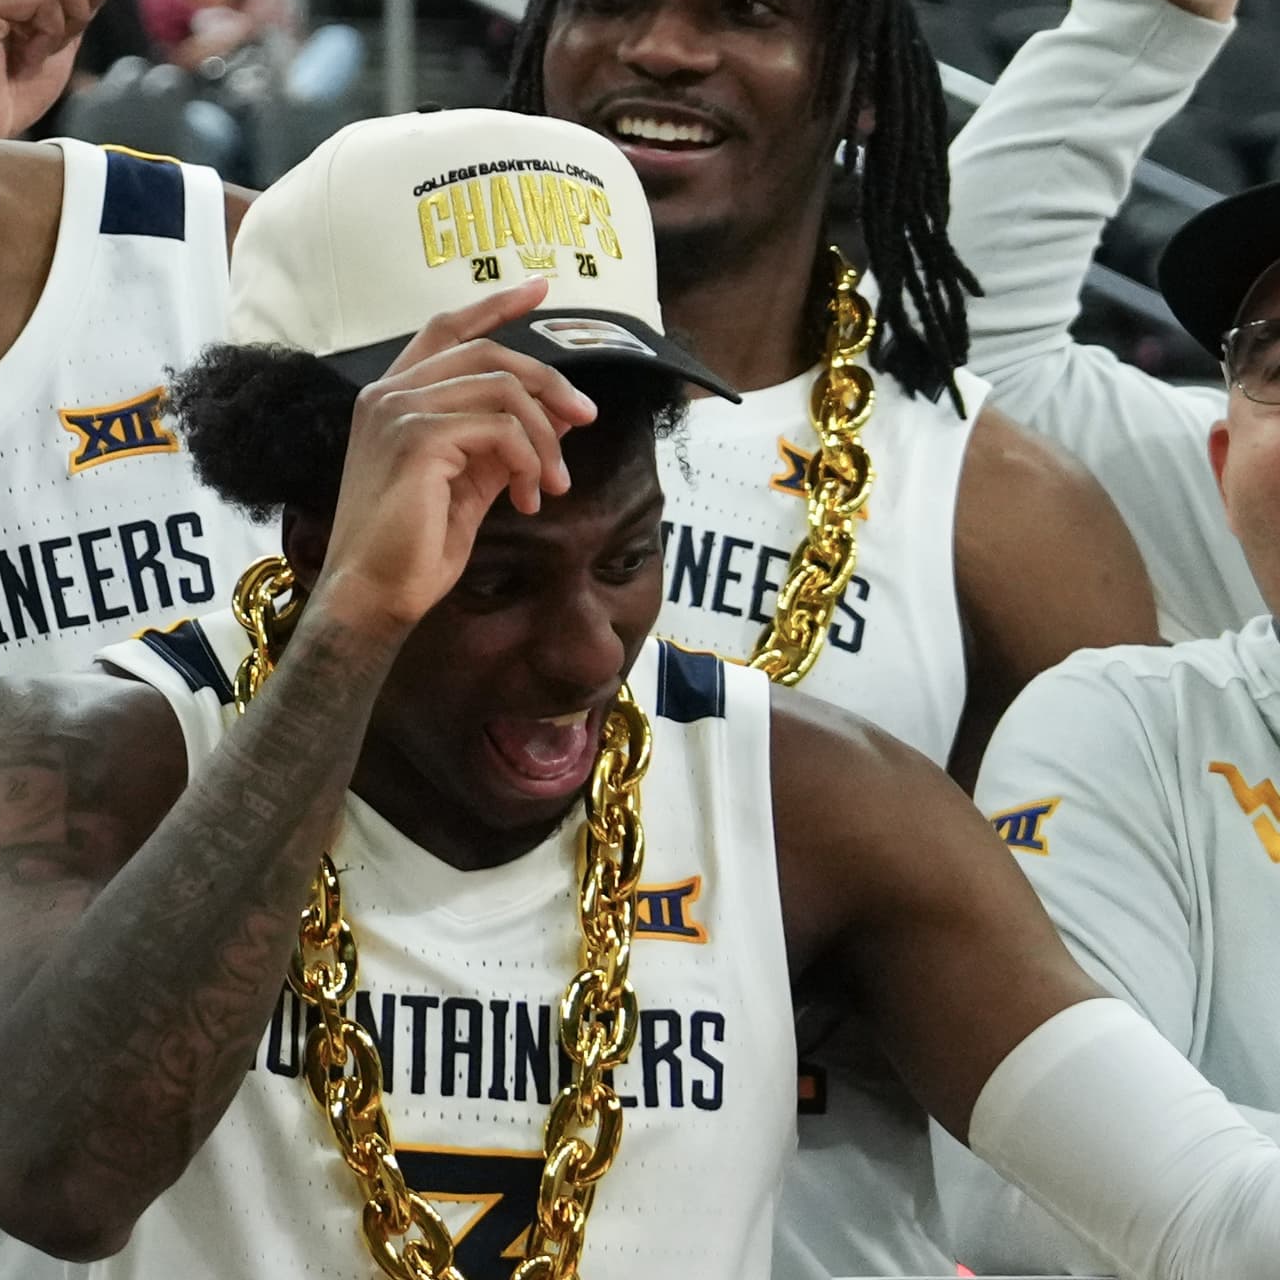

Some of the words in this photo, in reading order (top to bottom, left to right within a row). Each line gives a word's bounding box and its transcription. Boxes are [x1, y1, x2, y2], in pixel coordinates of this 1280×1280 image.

[413, 165, 477, 196] COLLEGE
[479, 159, 565, 176] BASKETBALL
[566, 164, 605, 188] CROWN
[418, 174, 623, 268] CHAMPS
[472, 256, 500, 282] 20
[576, 252, 598, 278] 26
